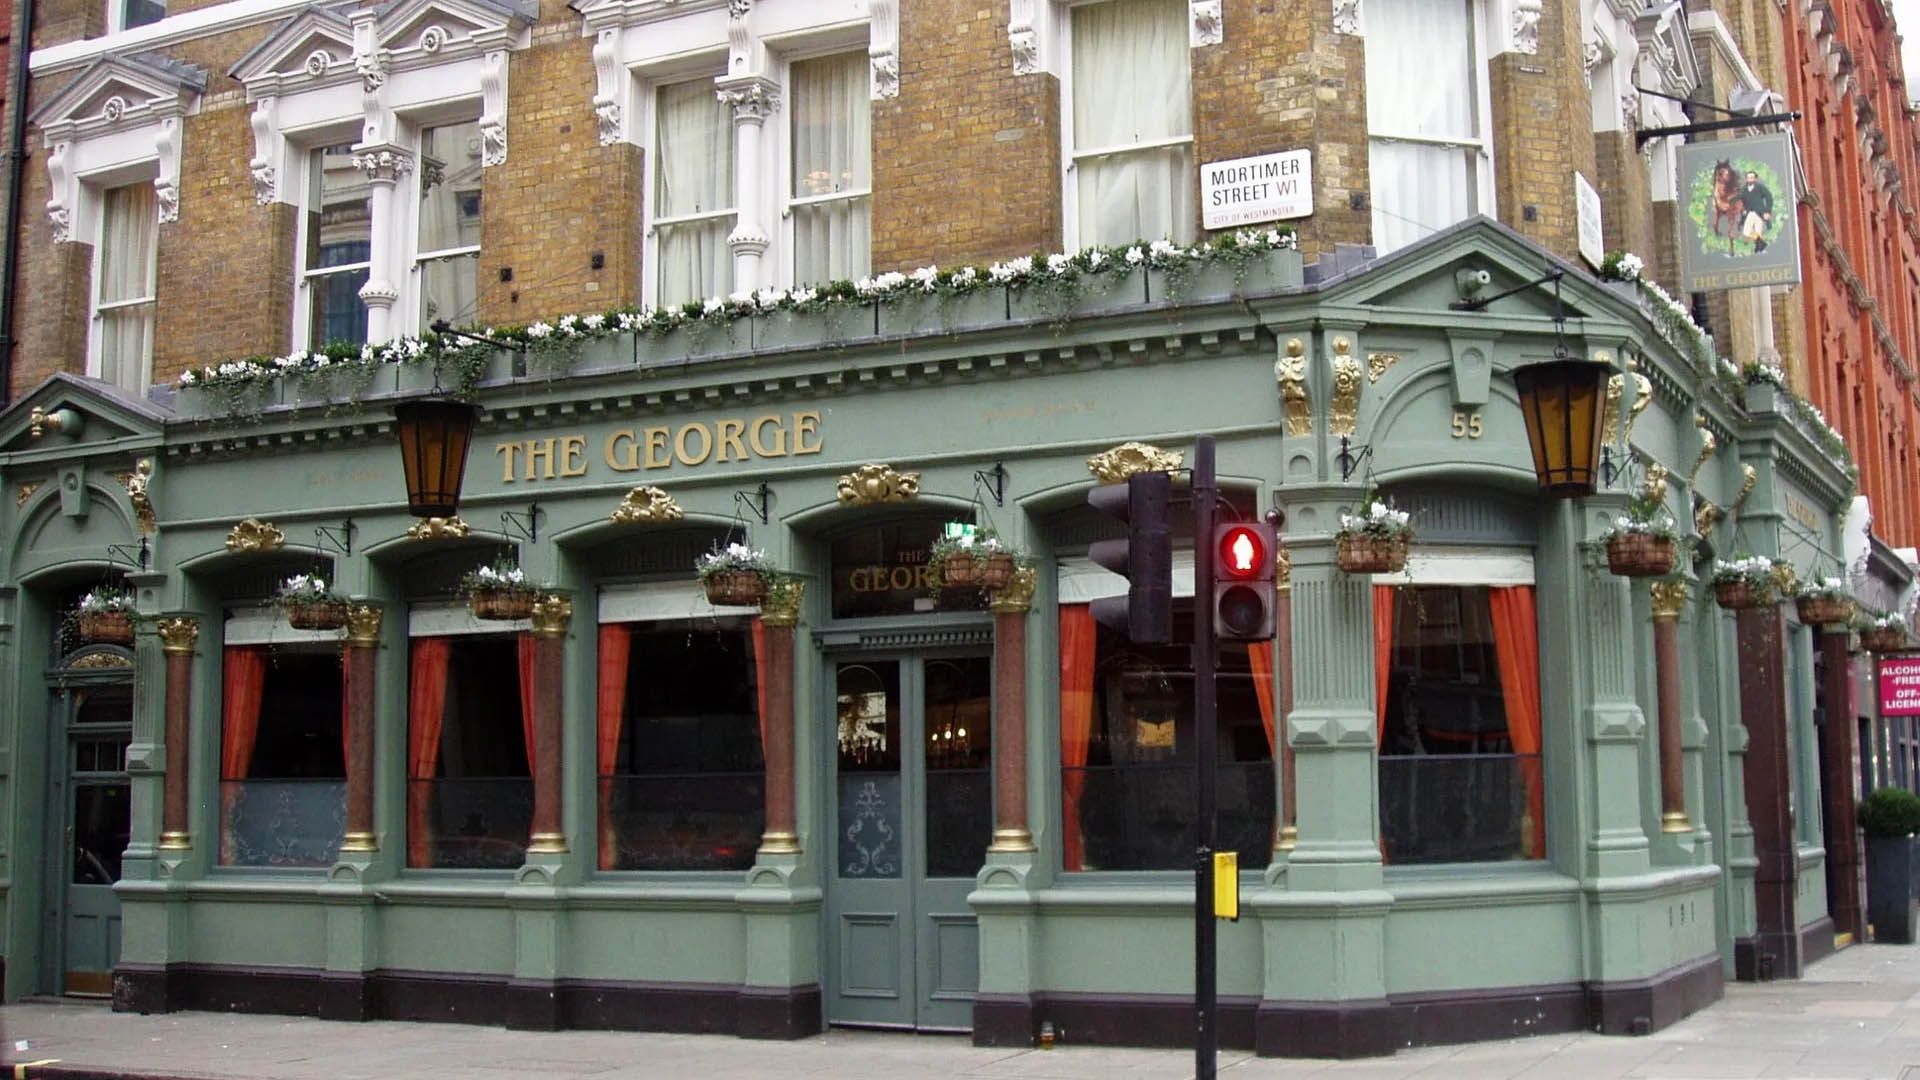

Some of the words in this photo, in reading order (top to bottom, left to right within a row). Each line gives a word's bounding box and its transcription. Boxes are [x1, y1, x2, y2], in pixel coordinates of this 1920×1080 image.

[1211, 158, 1300, 186] MORTIMER
[1212, 183, 1270, 207] STREET
[1276, 179, 1298, 197] W1
[1243, 205, 1295, 220] WESTMINSTER
[1691, 274, 1720, 289] THE
[1725, 267, 1793, 285] GEORGE
[1452, 412, 1483, 439] 55
[496, 434, 588, 482] THE
[604, 410, 823, 472] GEORGE
[849, 565, 938, 591] GEOR
[1881, 666, 1920, 676] ALCOH
[1885, 699, 1920, 709] LICEN
